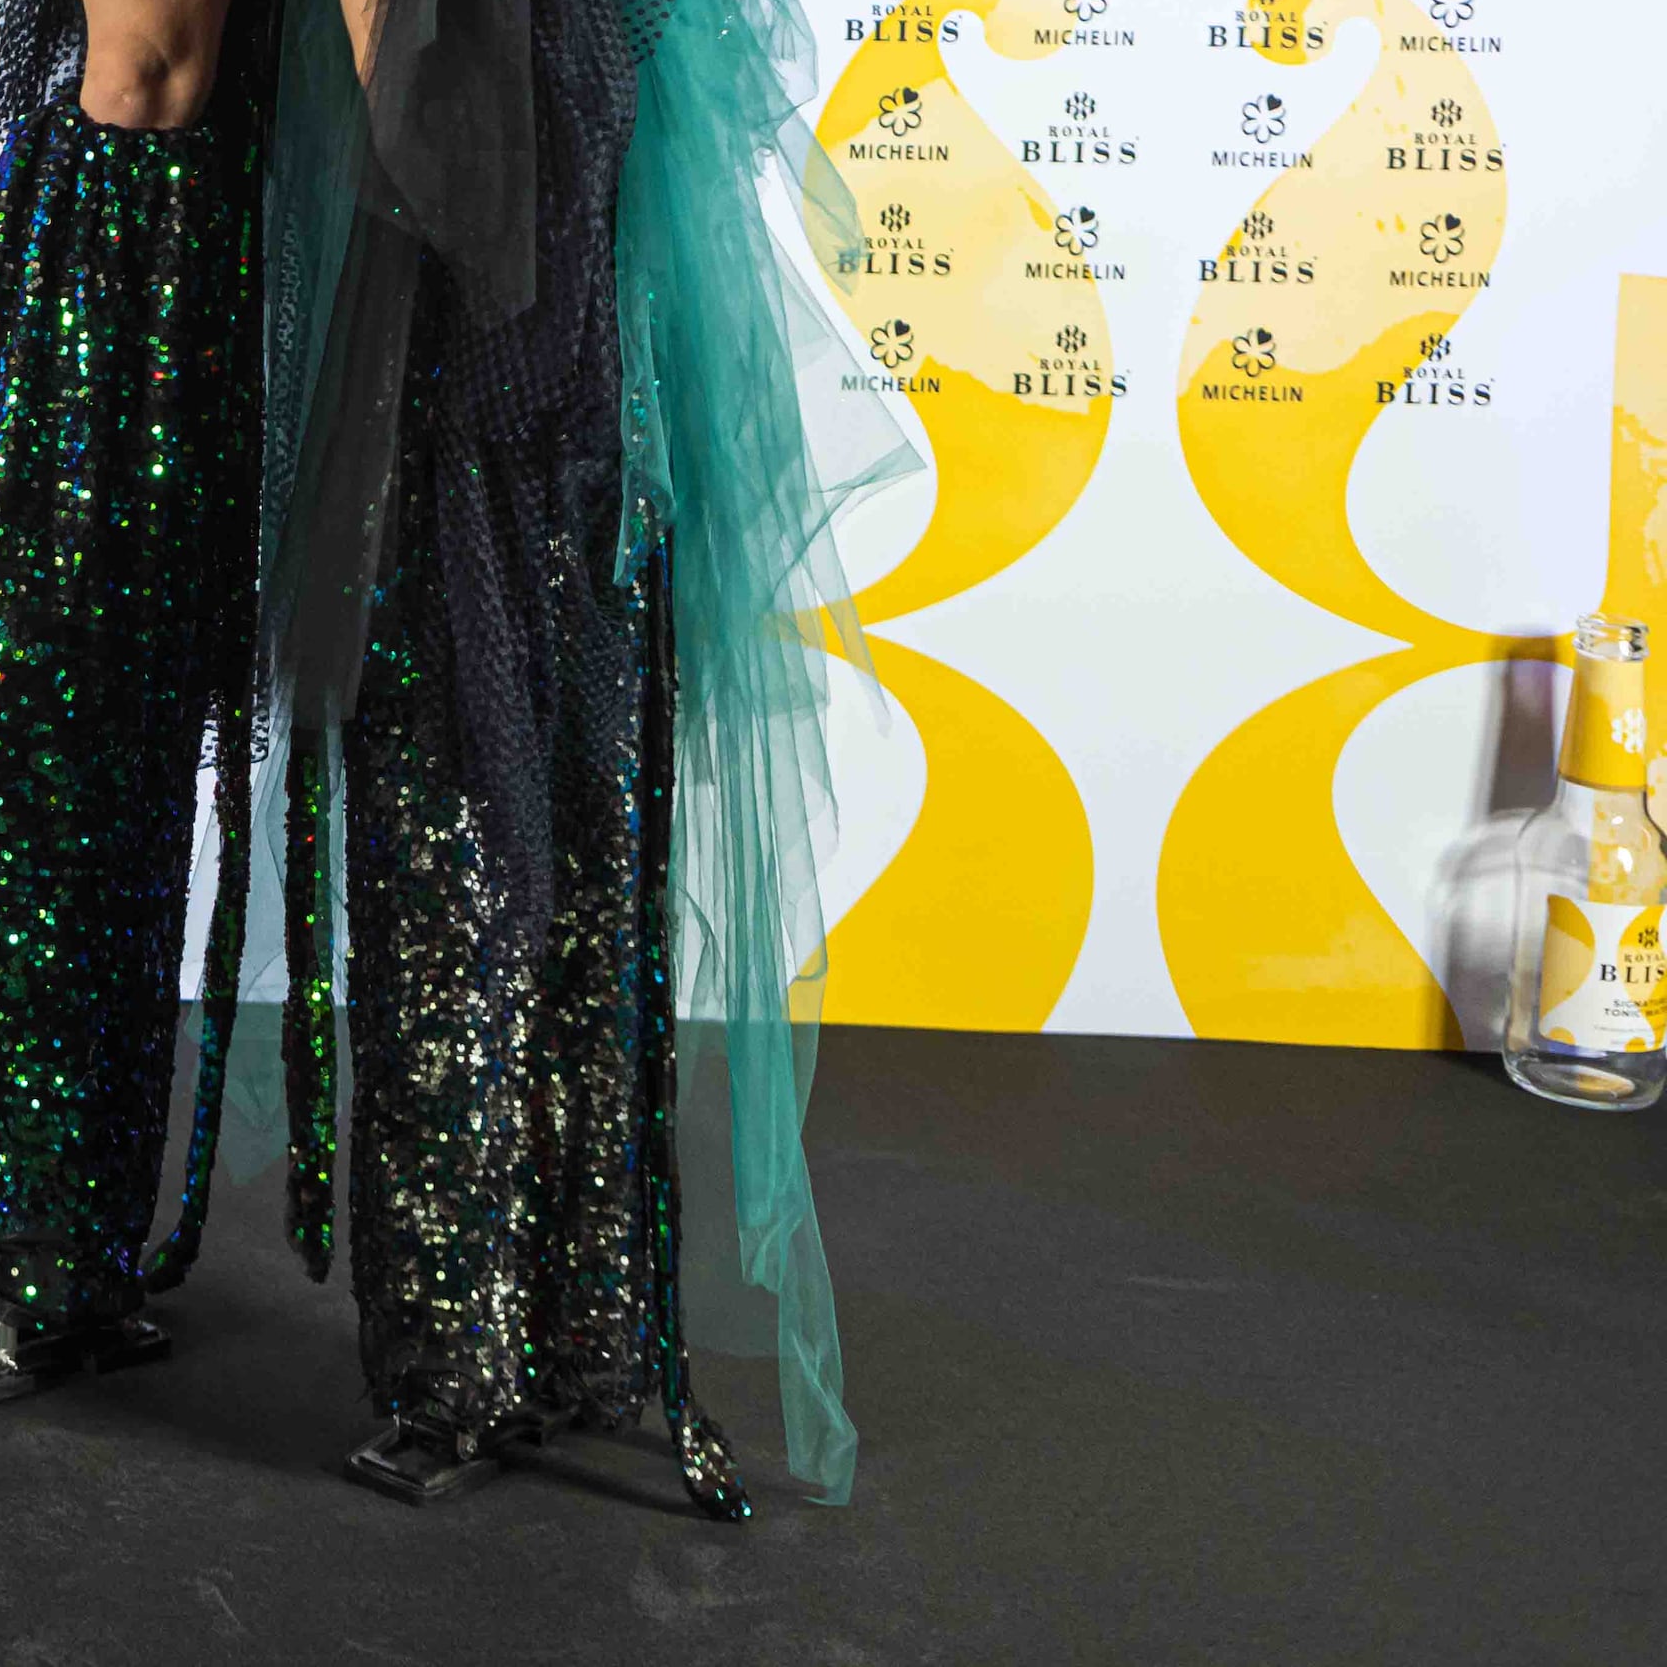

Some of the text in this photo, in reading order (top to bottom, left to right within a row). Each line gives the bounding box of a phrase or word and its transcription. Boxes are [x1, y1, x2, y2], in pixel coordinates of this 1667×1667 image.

[871, 4, 933, 16] ROYAL
[1235, 11, 1296, 23] ROYAL
[844, 18, 959, 43] BLISS
[1034, 29, 1134, 46] MICHELIN
[1207, 25, 1323, 50] BLISS
[1400, 36, 1501, 53] MICHELIN
[1049, 125, 1109, 138] ROYAL
[1414, 132, 1477, 146] ROYAL
[849, 143, 949, 161] MICHELIN
[1021, 140, 1137, 164] BLISS
[1212, 151, 1313, 168] MICHELIN
[1386, 147, 1503, 172] BLISS
[863, 236, 925, 250] ROYAL
[1226, 245, 1288, 258] ROYAL
[1025, 262, 1125, 280] MICHELIN
[1198, 258, 1314, 284] BLISS
[1390, 270, 1490, 288] MICHELIN
[1040, 358, 1101, 372] ROYAL
[1403, 367, 1465, 380] ROYAL
[841, 375, 941, 393] MICHELIN
[1013, 372, 1127, 398] BLISS
[1202, 384, 1303, 402] MICHELIN
[1375, 381, 1491, 406] BLISS
